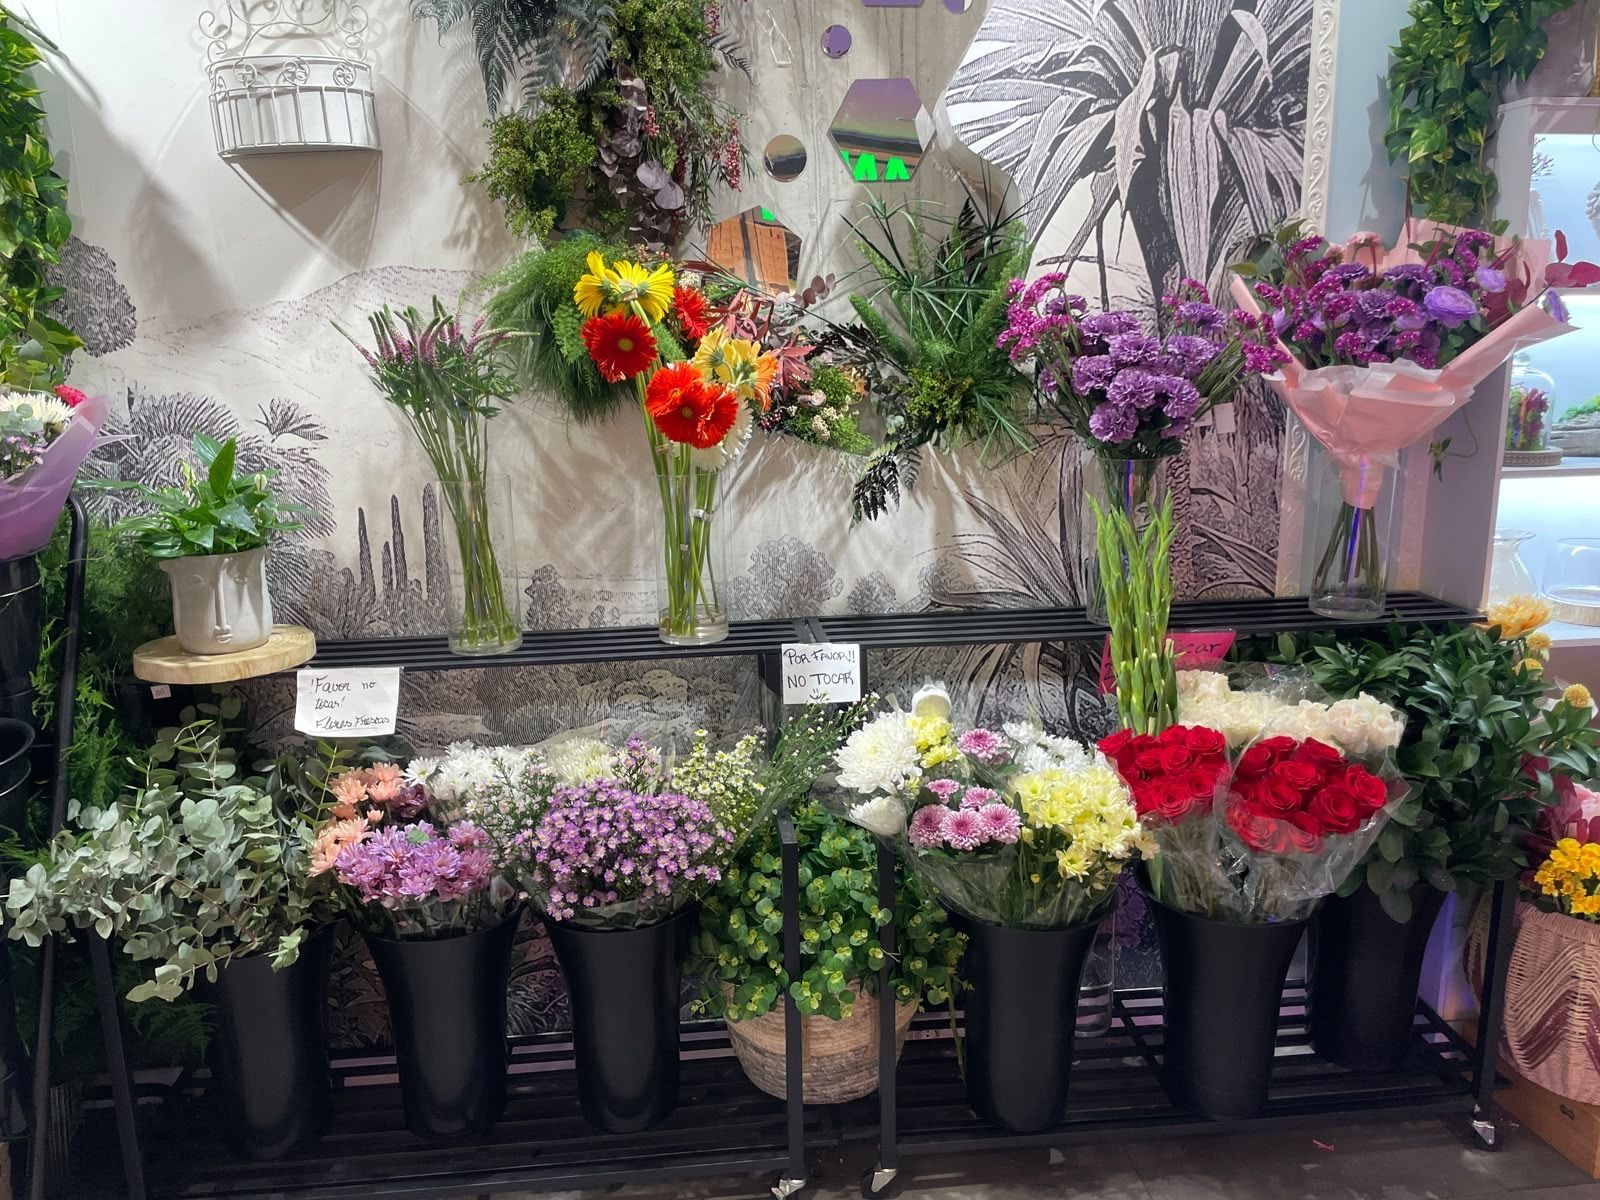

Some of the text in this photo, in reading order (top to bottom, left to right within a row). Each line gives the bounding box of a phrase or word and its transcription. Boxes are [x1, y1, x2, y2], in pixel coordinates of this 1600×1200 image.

[783, 648, 811, 664] POR
[361, 681, 376, 690] no
[787, 671, 854, 688] NO TOCAR
